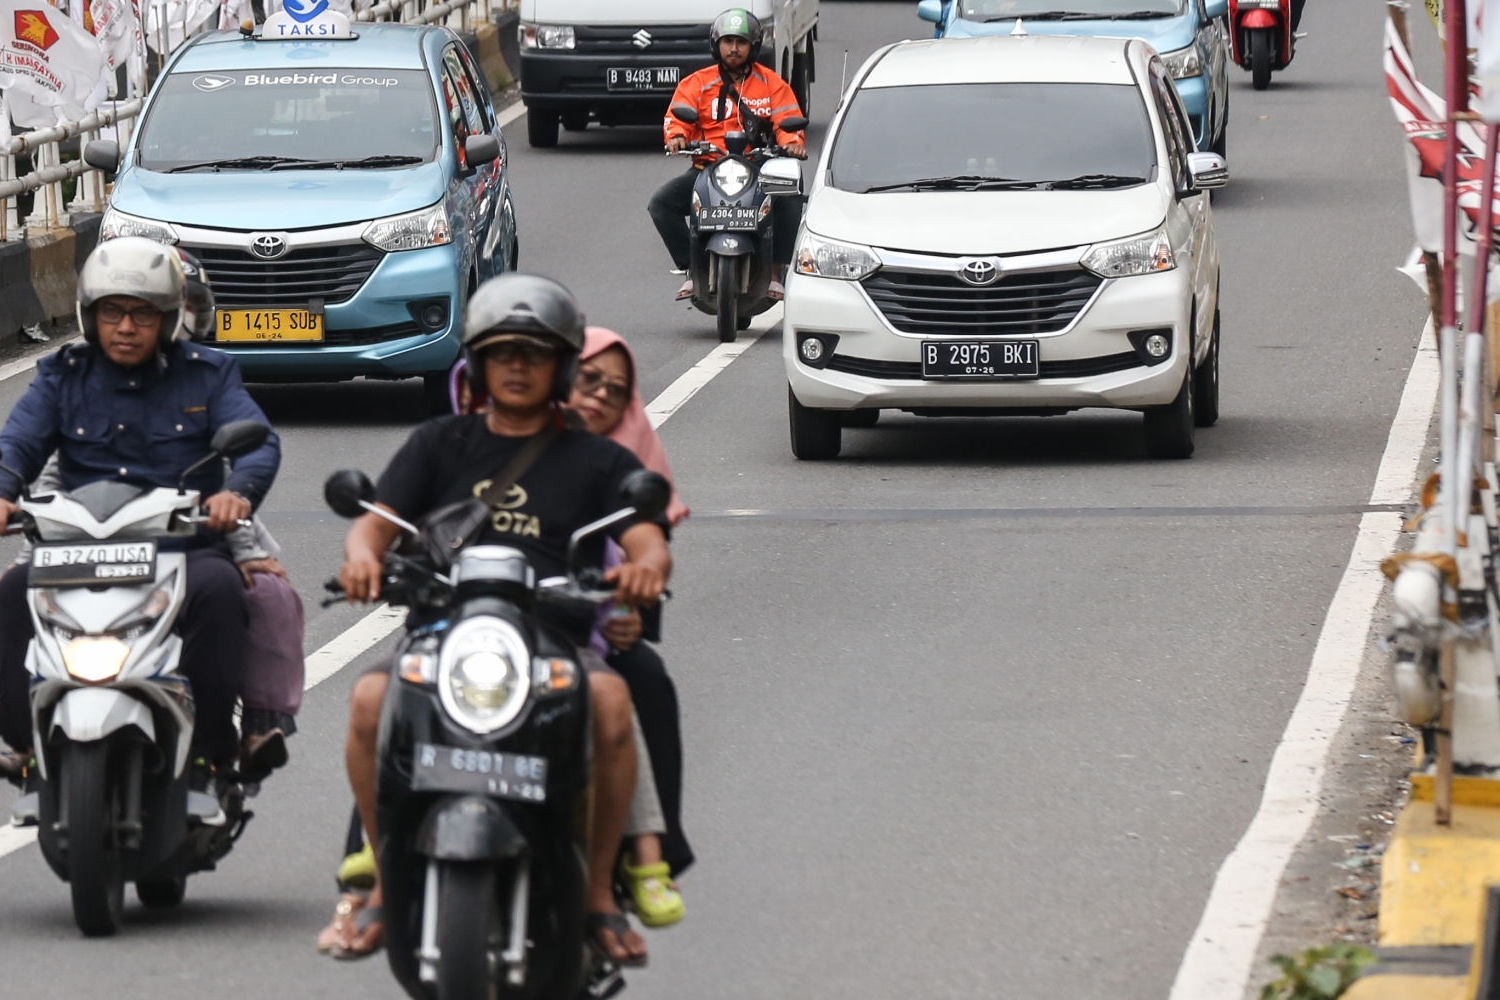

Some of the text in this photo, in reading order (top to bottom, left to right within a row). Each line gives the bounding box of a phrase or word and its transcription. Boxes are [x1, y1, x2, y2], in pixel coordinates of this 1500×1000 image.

[277, 23, 337, 37] TAKSI
[243, 72, 399, 89] Bluebird Group
[610, 68, 677, 84] B 9483 NAN
[702, 209, 708, 220] B
[711, 209, 733, 219] 4304
[222, 311, 317, 331] B 1415 SUB
[927, 344, 1032, 365] B 2975 BKI
[491, 510, 541, 539] OTA
[115, 546, 148, 563] USA
